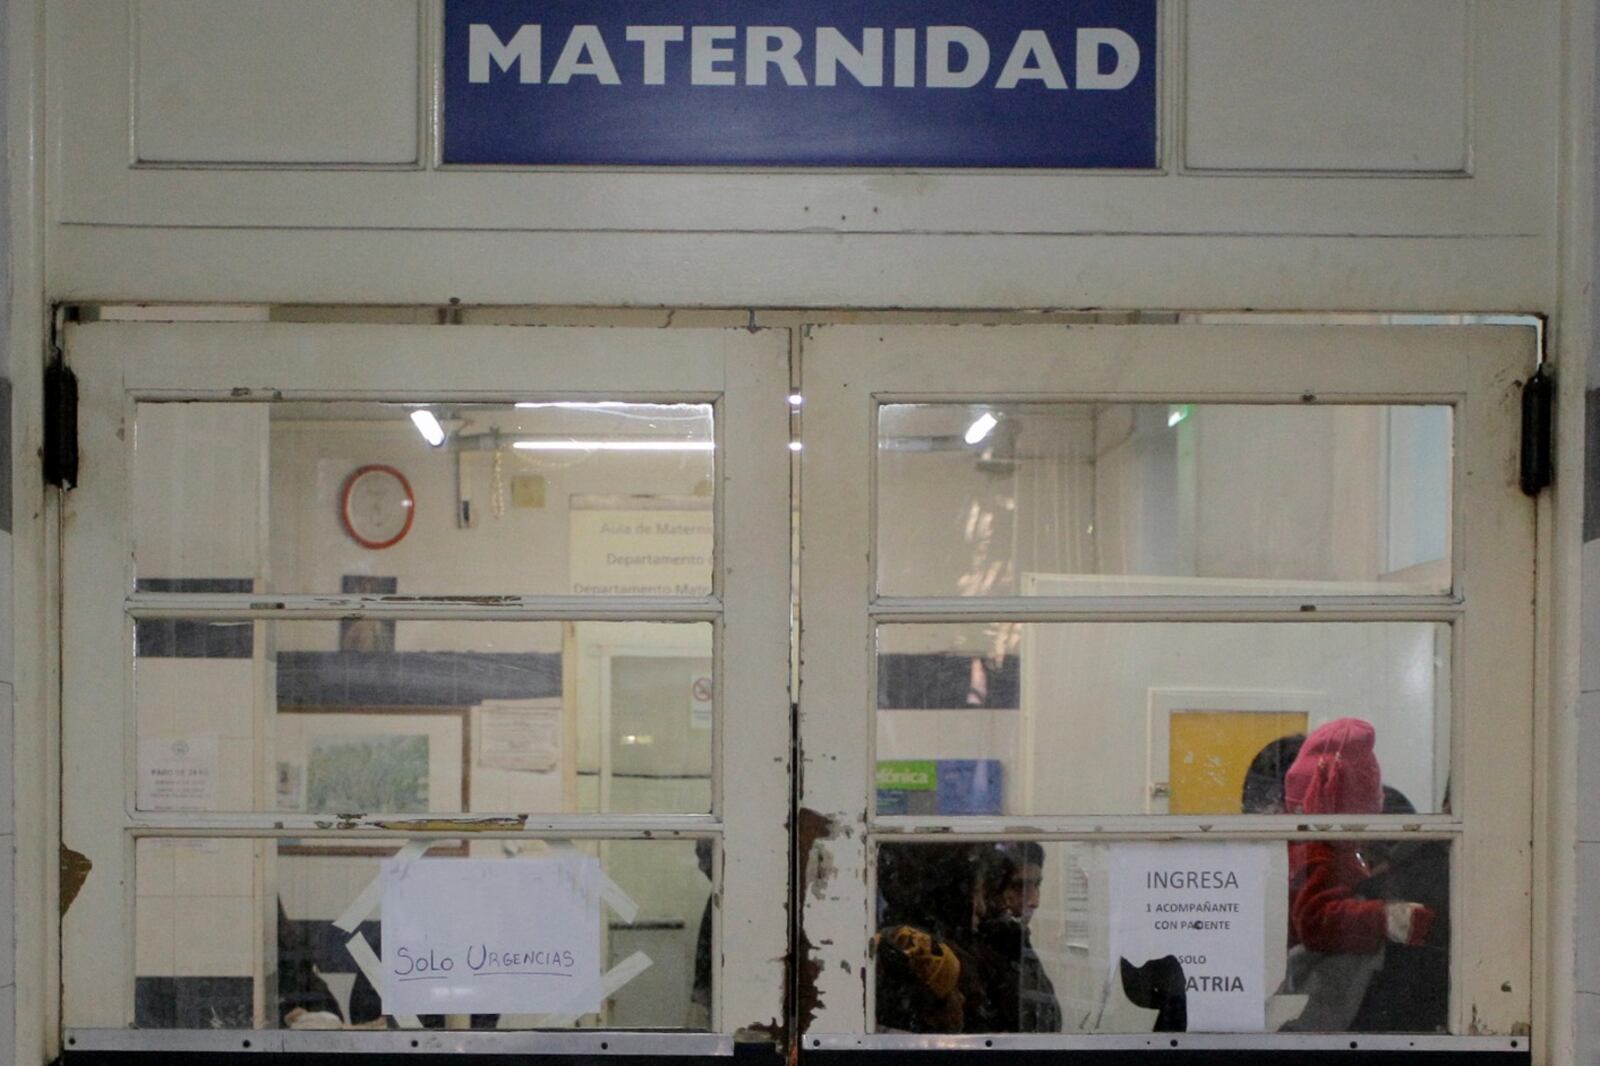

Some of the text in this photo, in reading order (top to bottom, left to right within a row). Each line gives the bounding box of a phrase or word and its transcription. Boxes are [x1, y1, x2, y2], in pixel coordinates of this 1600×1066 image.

[467, 23, 1141, 91] MATERNIDAD
[606, 553, 704, 567] Departamento
[1146, 871, 1239, 889] INGRESA
[1146, 901, 1240, 913] 1 ACOMPAÑANTE
[1154, 920, 1178, 930] CON
[466, 944, 575, 971] URGENCIAS
[1178, 955, 1207, 965] SOLO
[1185, 976, 1245, 992] ATRIA
